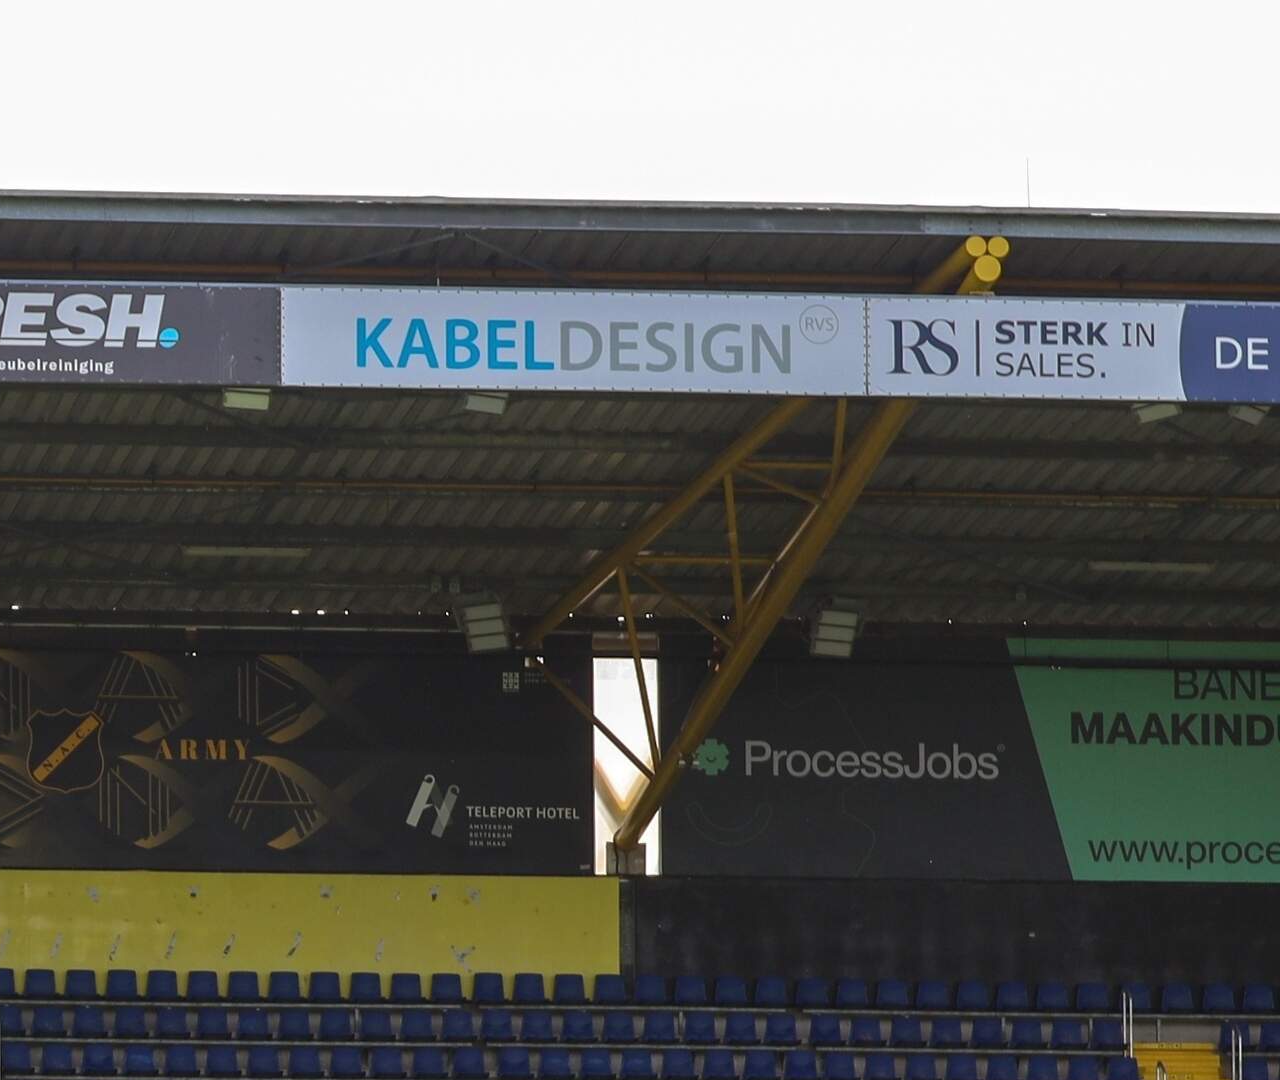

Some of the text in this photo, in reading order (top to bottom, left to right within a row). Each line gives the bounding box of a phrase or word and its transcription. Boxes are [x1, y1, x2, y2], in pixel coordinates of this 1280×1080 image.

[803, 315, 834, 332] RVS
[994, 319, 1156, 348] STERK IN
[355, 317, 792, 375] KABELDESIGN
[886, 318, 960, 377] RS
[1215, 336, 1269, 370] DE
[995, 352, 1107, 379] SALES.
[1070, 711, 1280, 747] MAAKIND
[155, 738, 251, 761] ARMY
[466, 805, 580, 820] TELEPORT HOTEL
